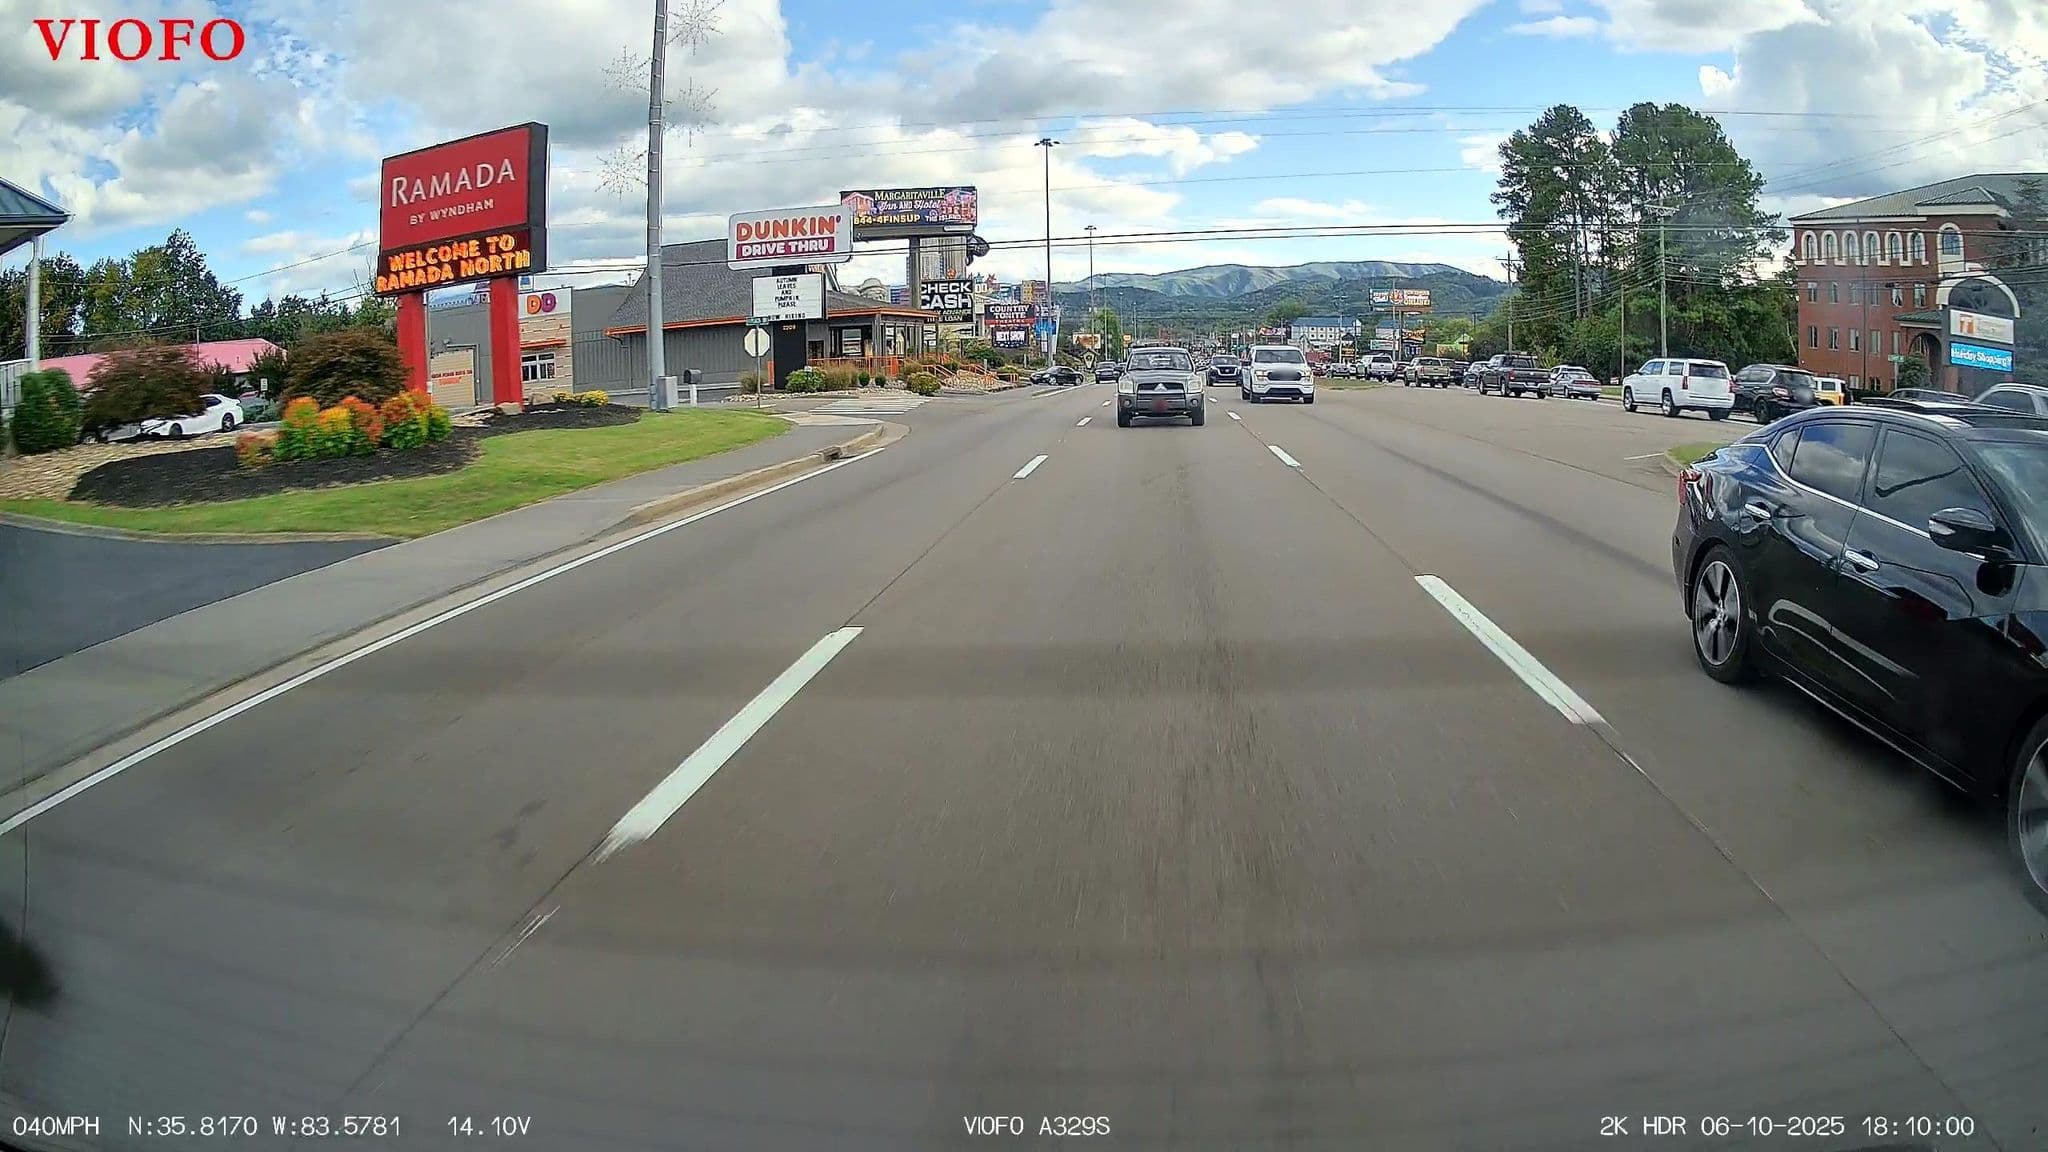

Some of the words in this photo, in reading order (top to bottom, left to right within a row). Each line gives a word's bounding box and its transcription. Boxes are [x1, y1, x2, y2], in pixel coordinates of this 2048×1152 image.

[391, 158, 515, 207] RAMADA
[874, 189, 945, 201] MARGARITAVILLE
[410, 213, 426, 225] BY
[429, 199, 494, 221] WYNDHAM
[879, 201, 898, 211] Inn
[899, 201, 913, 209] AND
[913, 200, 940, 210] Hotel
[736, 215, 841, 242] DUNKIN'
[388, 239, 481, 272] WELCOME
[486, 234, 515, 253] TO
[742, 242, 785, 256] DRIVE
[789, 239, 829, 253] THRU
[376, 265, 454, 293] RAMADA
[460, 250, 531, 278] NORTH
[920, 282, 972, 294] CHECK
[527, 293, 557, 315] DD
[778, 301, 796, 309] PLEASE
[920, 294, 972, 310] CASH
[989, 304, 1030, 313] COUNTRY
